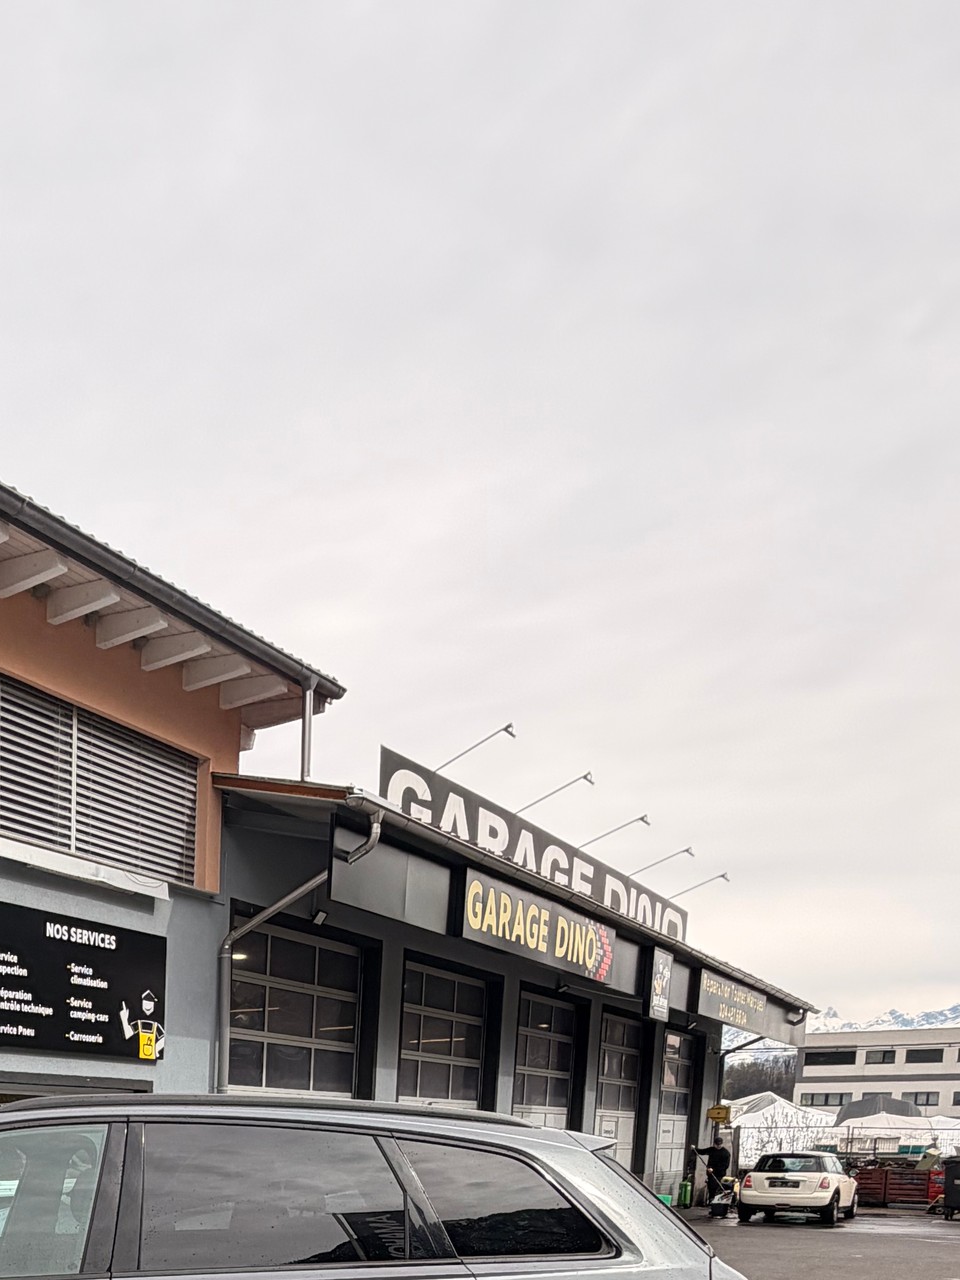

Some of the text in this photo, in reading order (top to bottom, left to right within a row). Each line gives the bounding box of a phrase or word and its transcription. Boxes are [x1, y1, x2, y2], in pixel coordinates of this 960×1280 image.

[467, 880, 598, 969] GARAGE DINO
[46, 922, 116, 950] NOS SERVICES
[70, 975, 108, 989] climatisation
[21, 1002, 53, 1016] technique
[70, 1010, 109, 1023] camping-cars
[18, 1025, 35, 1036] Pneu
